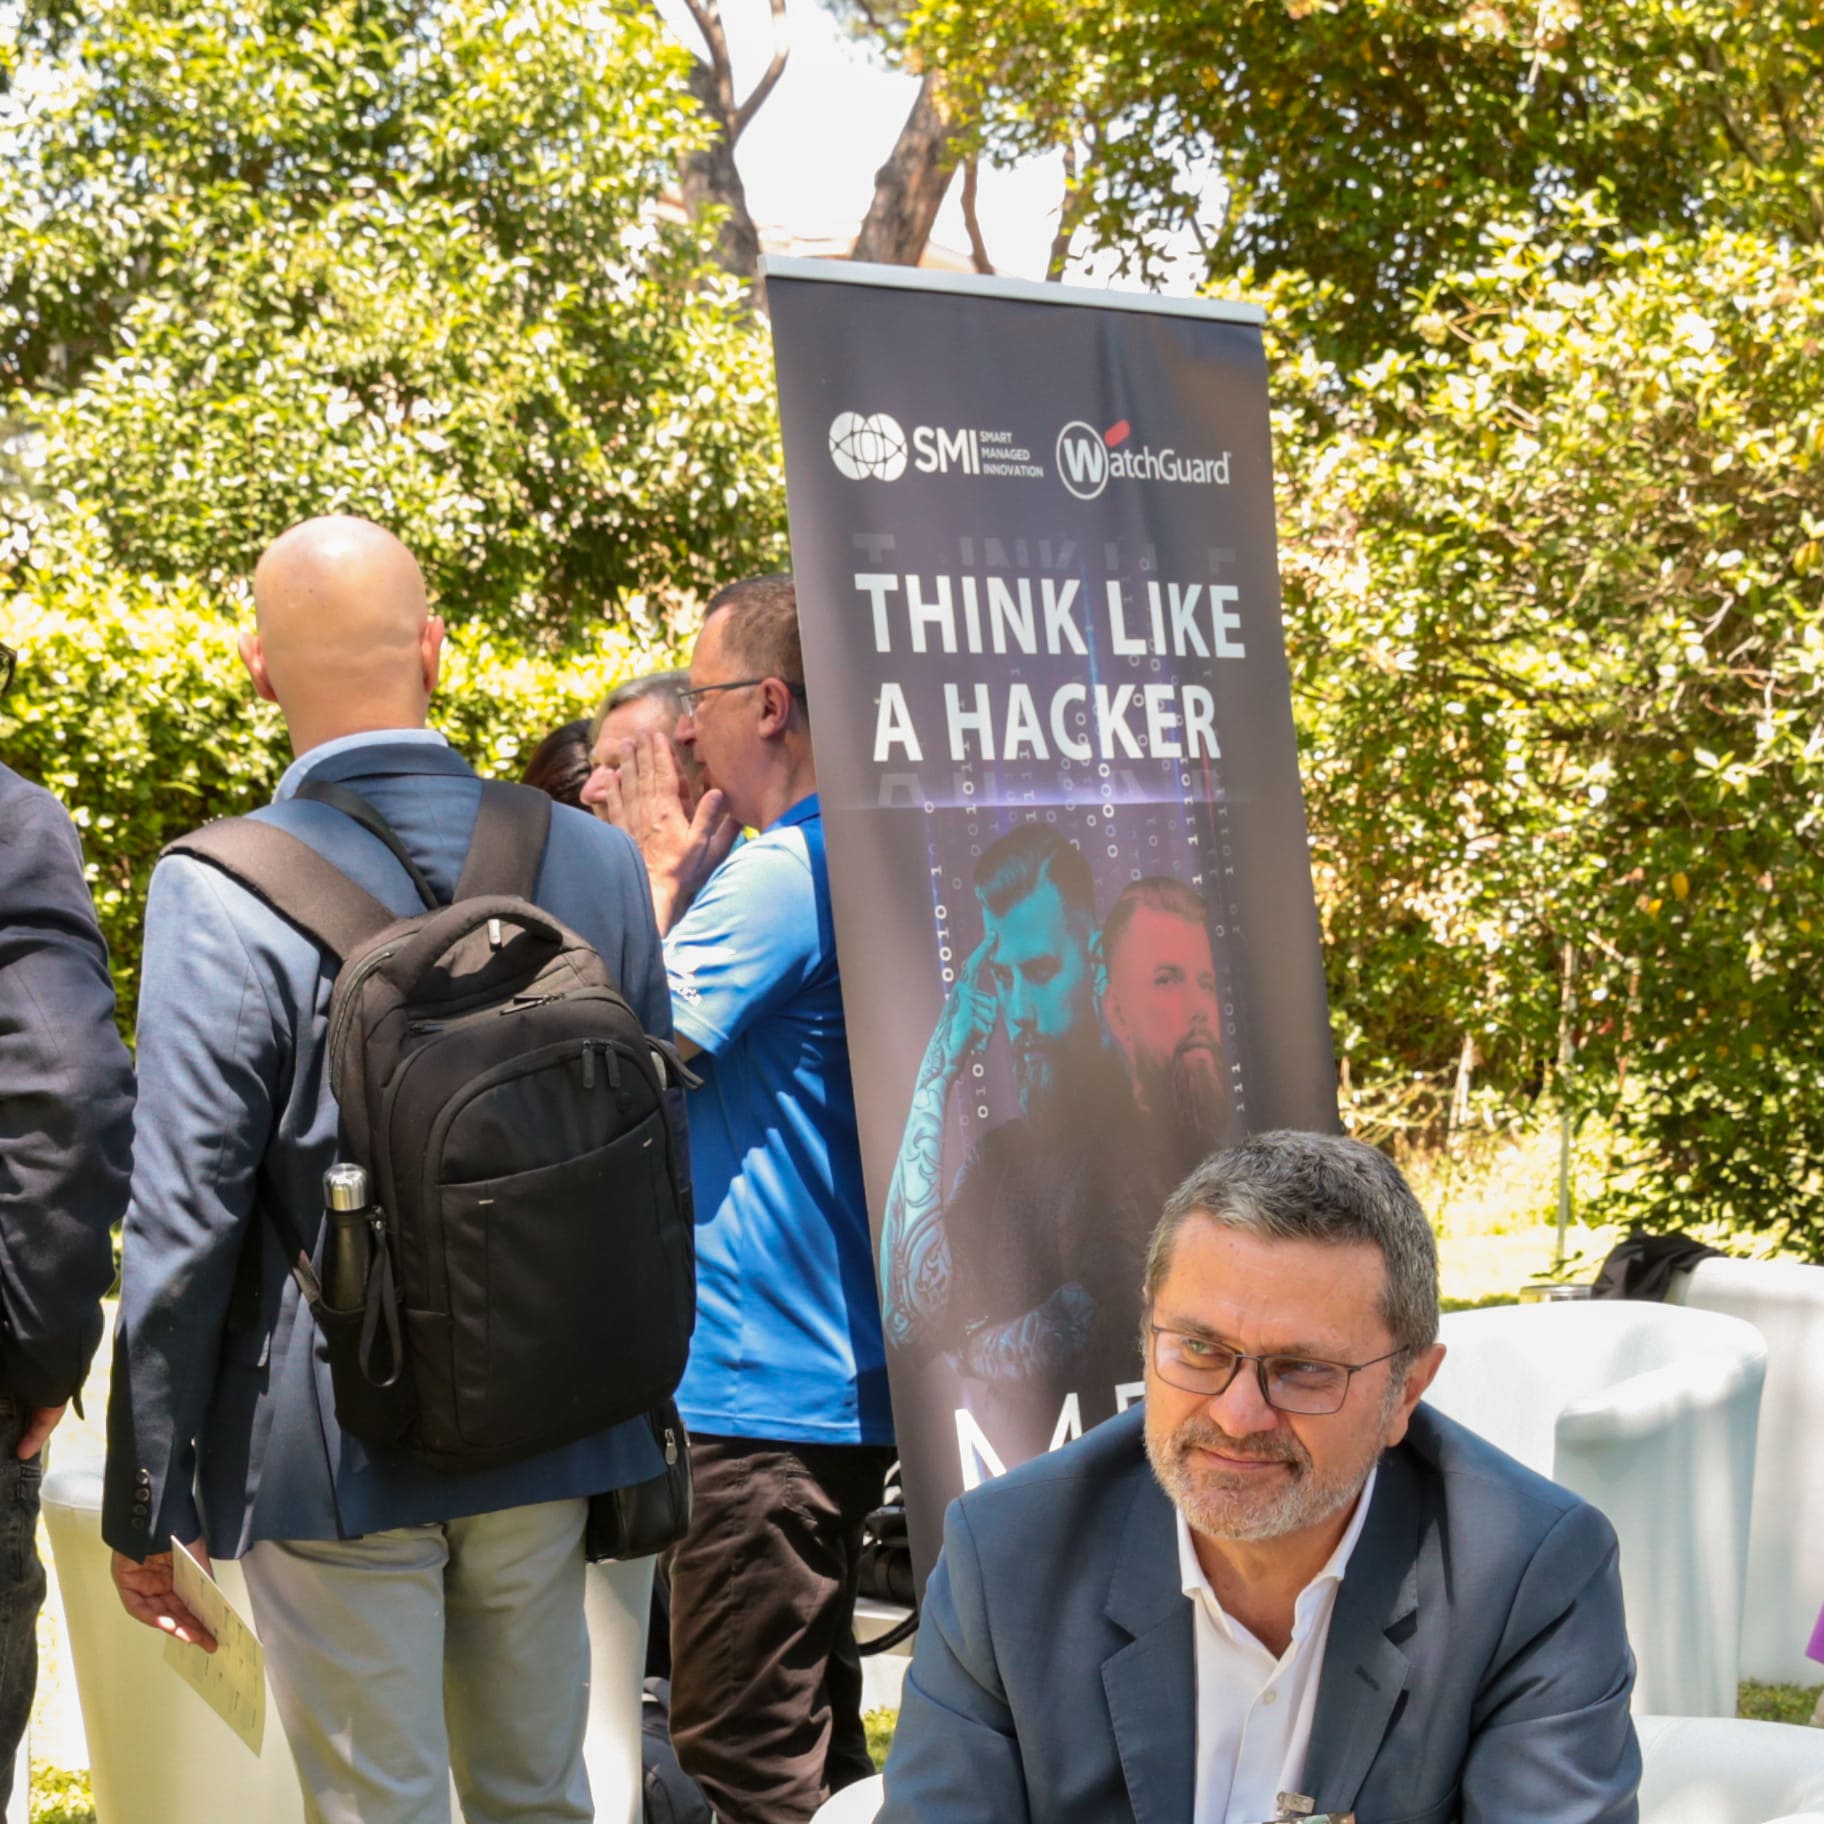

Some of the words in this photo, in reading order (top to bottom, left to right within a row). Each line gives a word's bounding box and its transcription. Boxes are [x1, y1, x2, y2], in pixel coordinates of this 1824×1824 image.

[914, 426, 980, 474] SMI
[980, 431, 1012, 444] SMART
[981, 447, 1030, 461] MANAGED
[983, 463, 1044, 478] INNOVATION
[854, 573, 1088, 656] THINK
[1106, 581, 1246, 660] LIKE
[873, 683, 923, 762] A
[943, 683, 1222, 761] HACKER
